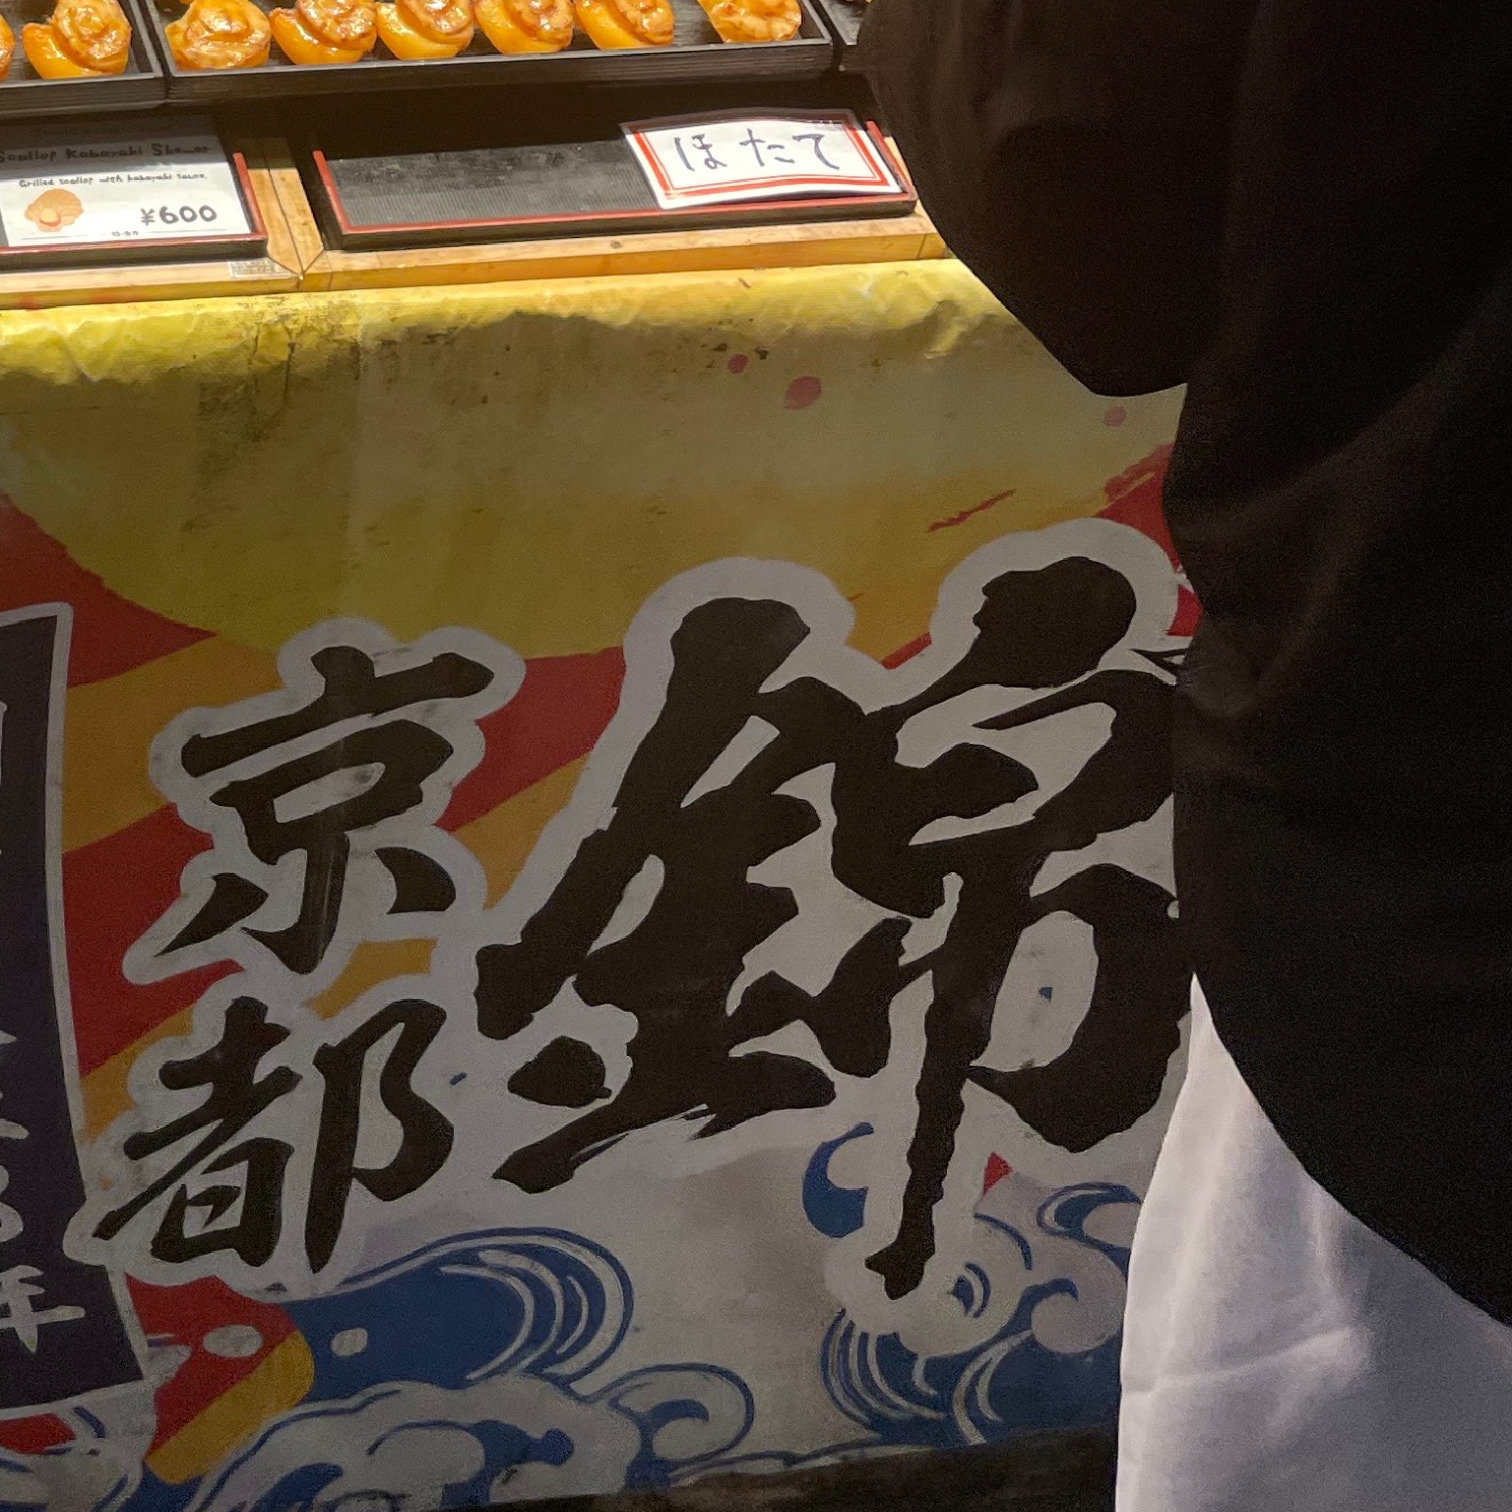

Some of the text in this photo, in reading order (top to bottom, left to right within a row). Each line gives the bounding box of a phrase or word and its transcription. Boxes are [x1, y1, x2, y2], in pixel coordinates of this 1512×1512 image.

[151, 142, 210, 157] Skewer
[673, 127, 841, 172] ほたて
[18, 178, 55, 189] Grilled
[59, 176, 94, 186] scallop
[99, 174, 124, 184] with
[140, 204, 218, 227] ¥600
[94, 645, 495, 1274] 京都
